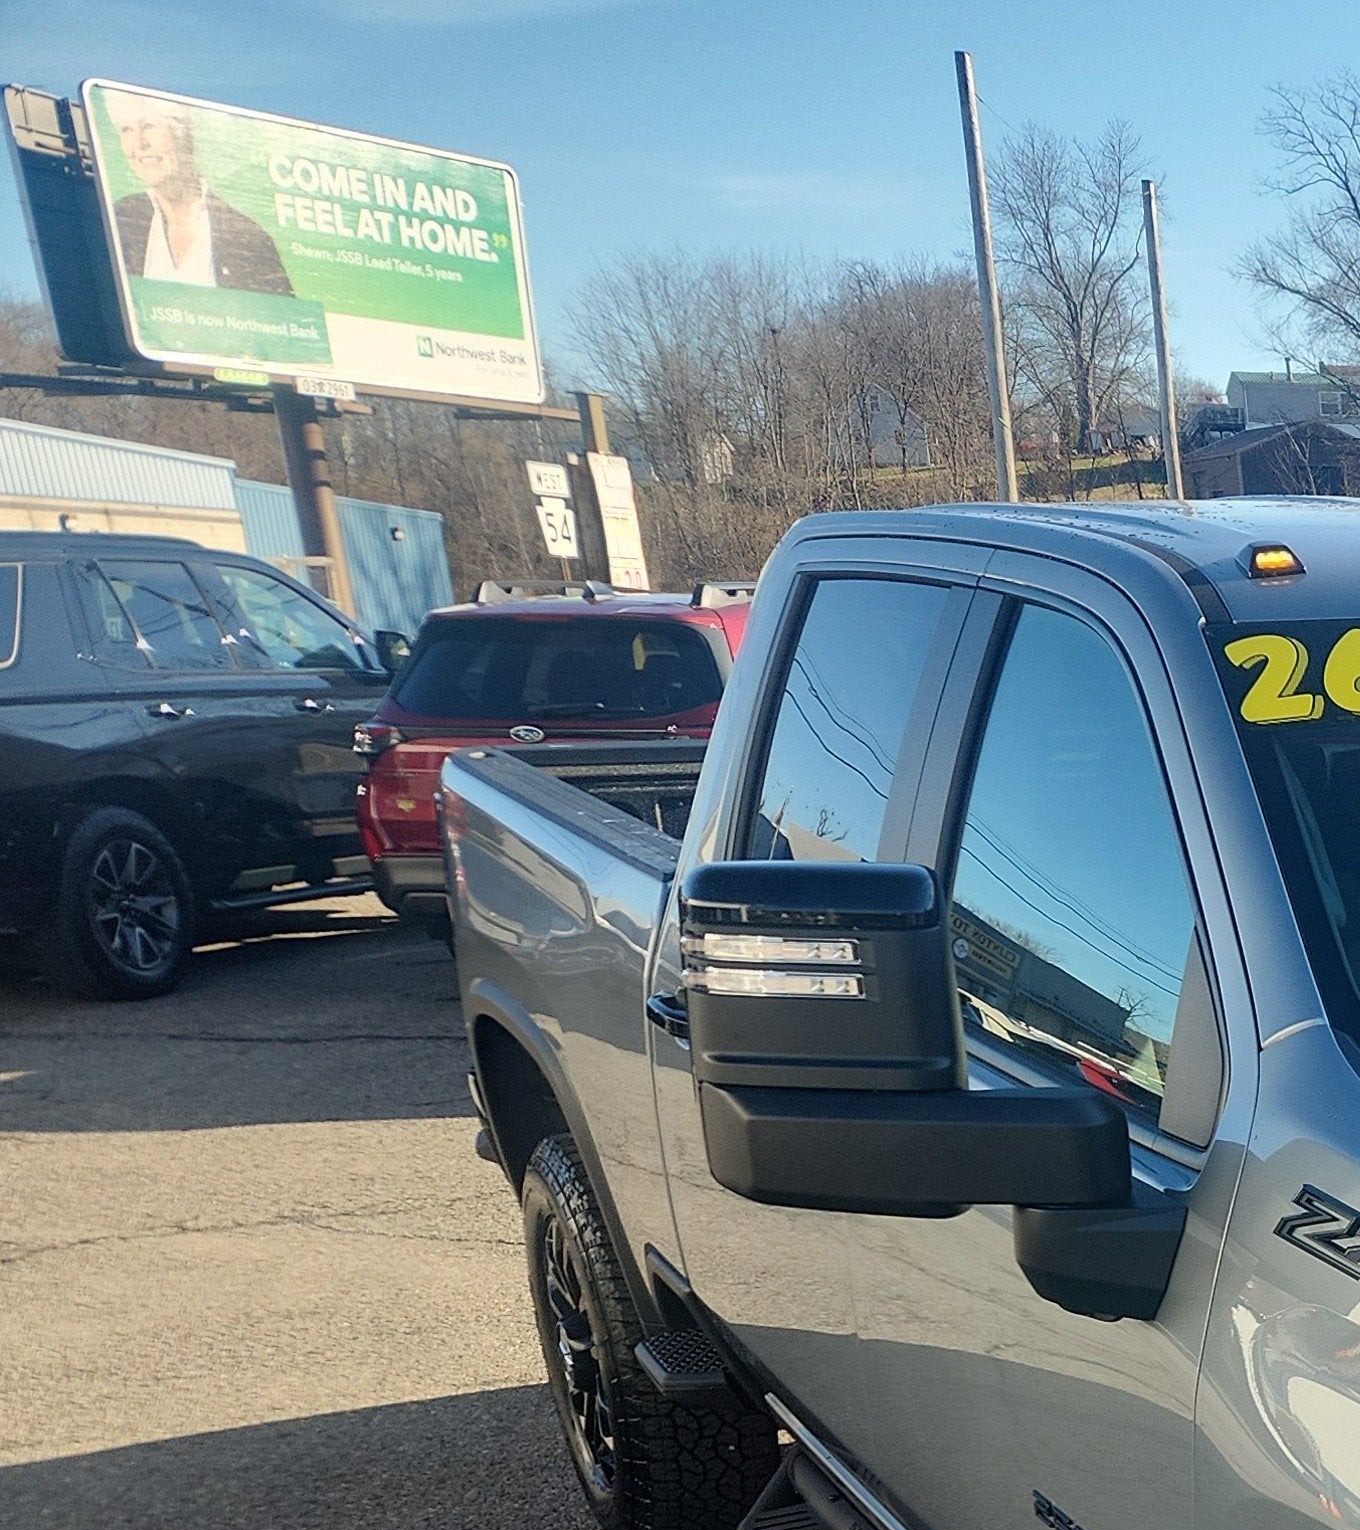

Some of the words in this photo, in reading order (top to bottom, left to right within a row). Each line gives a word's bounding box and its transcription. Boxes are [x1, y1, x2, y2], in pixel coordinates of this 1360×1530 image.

[372, 172, 408, 212] IN
[412, 182, 478, 222] AND
[274, 192, 355, 238] FEEL
[357, 208, 394, 244] AT
[335, 249, 362, 266] JSSB
[365, 254, 392, 270] Lead
[425, 264, 434, 278] 5
[434, 268, 463, 281] years
[150, 306, 182, 324] JSSB
[184, 311, 195, 325] is
[199, 315, 225, 329] now
[226, 314, 288, 336] Northwest
[290, 323, 319, 339] Bank
[435, 341, 496, 363] Northwest
[499, 350, 527, 366] Bank
[535, 470, 562, 490] WEST
[545, 512, 572, 544] 54
